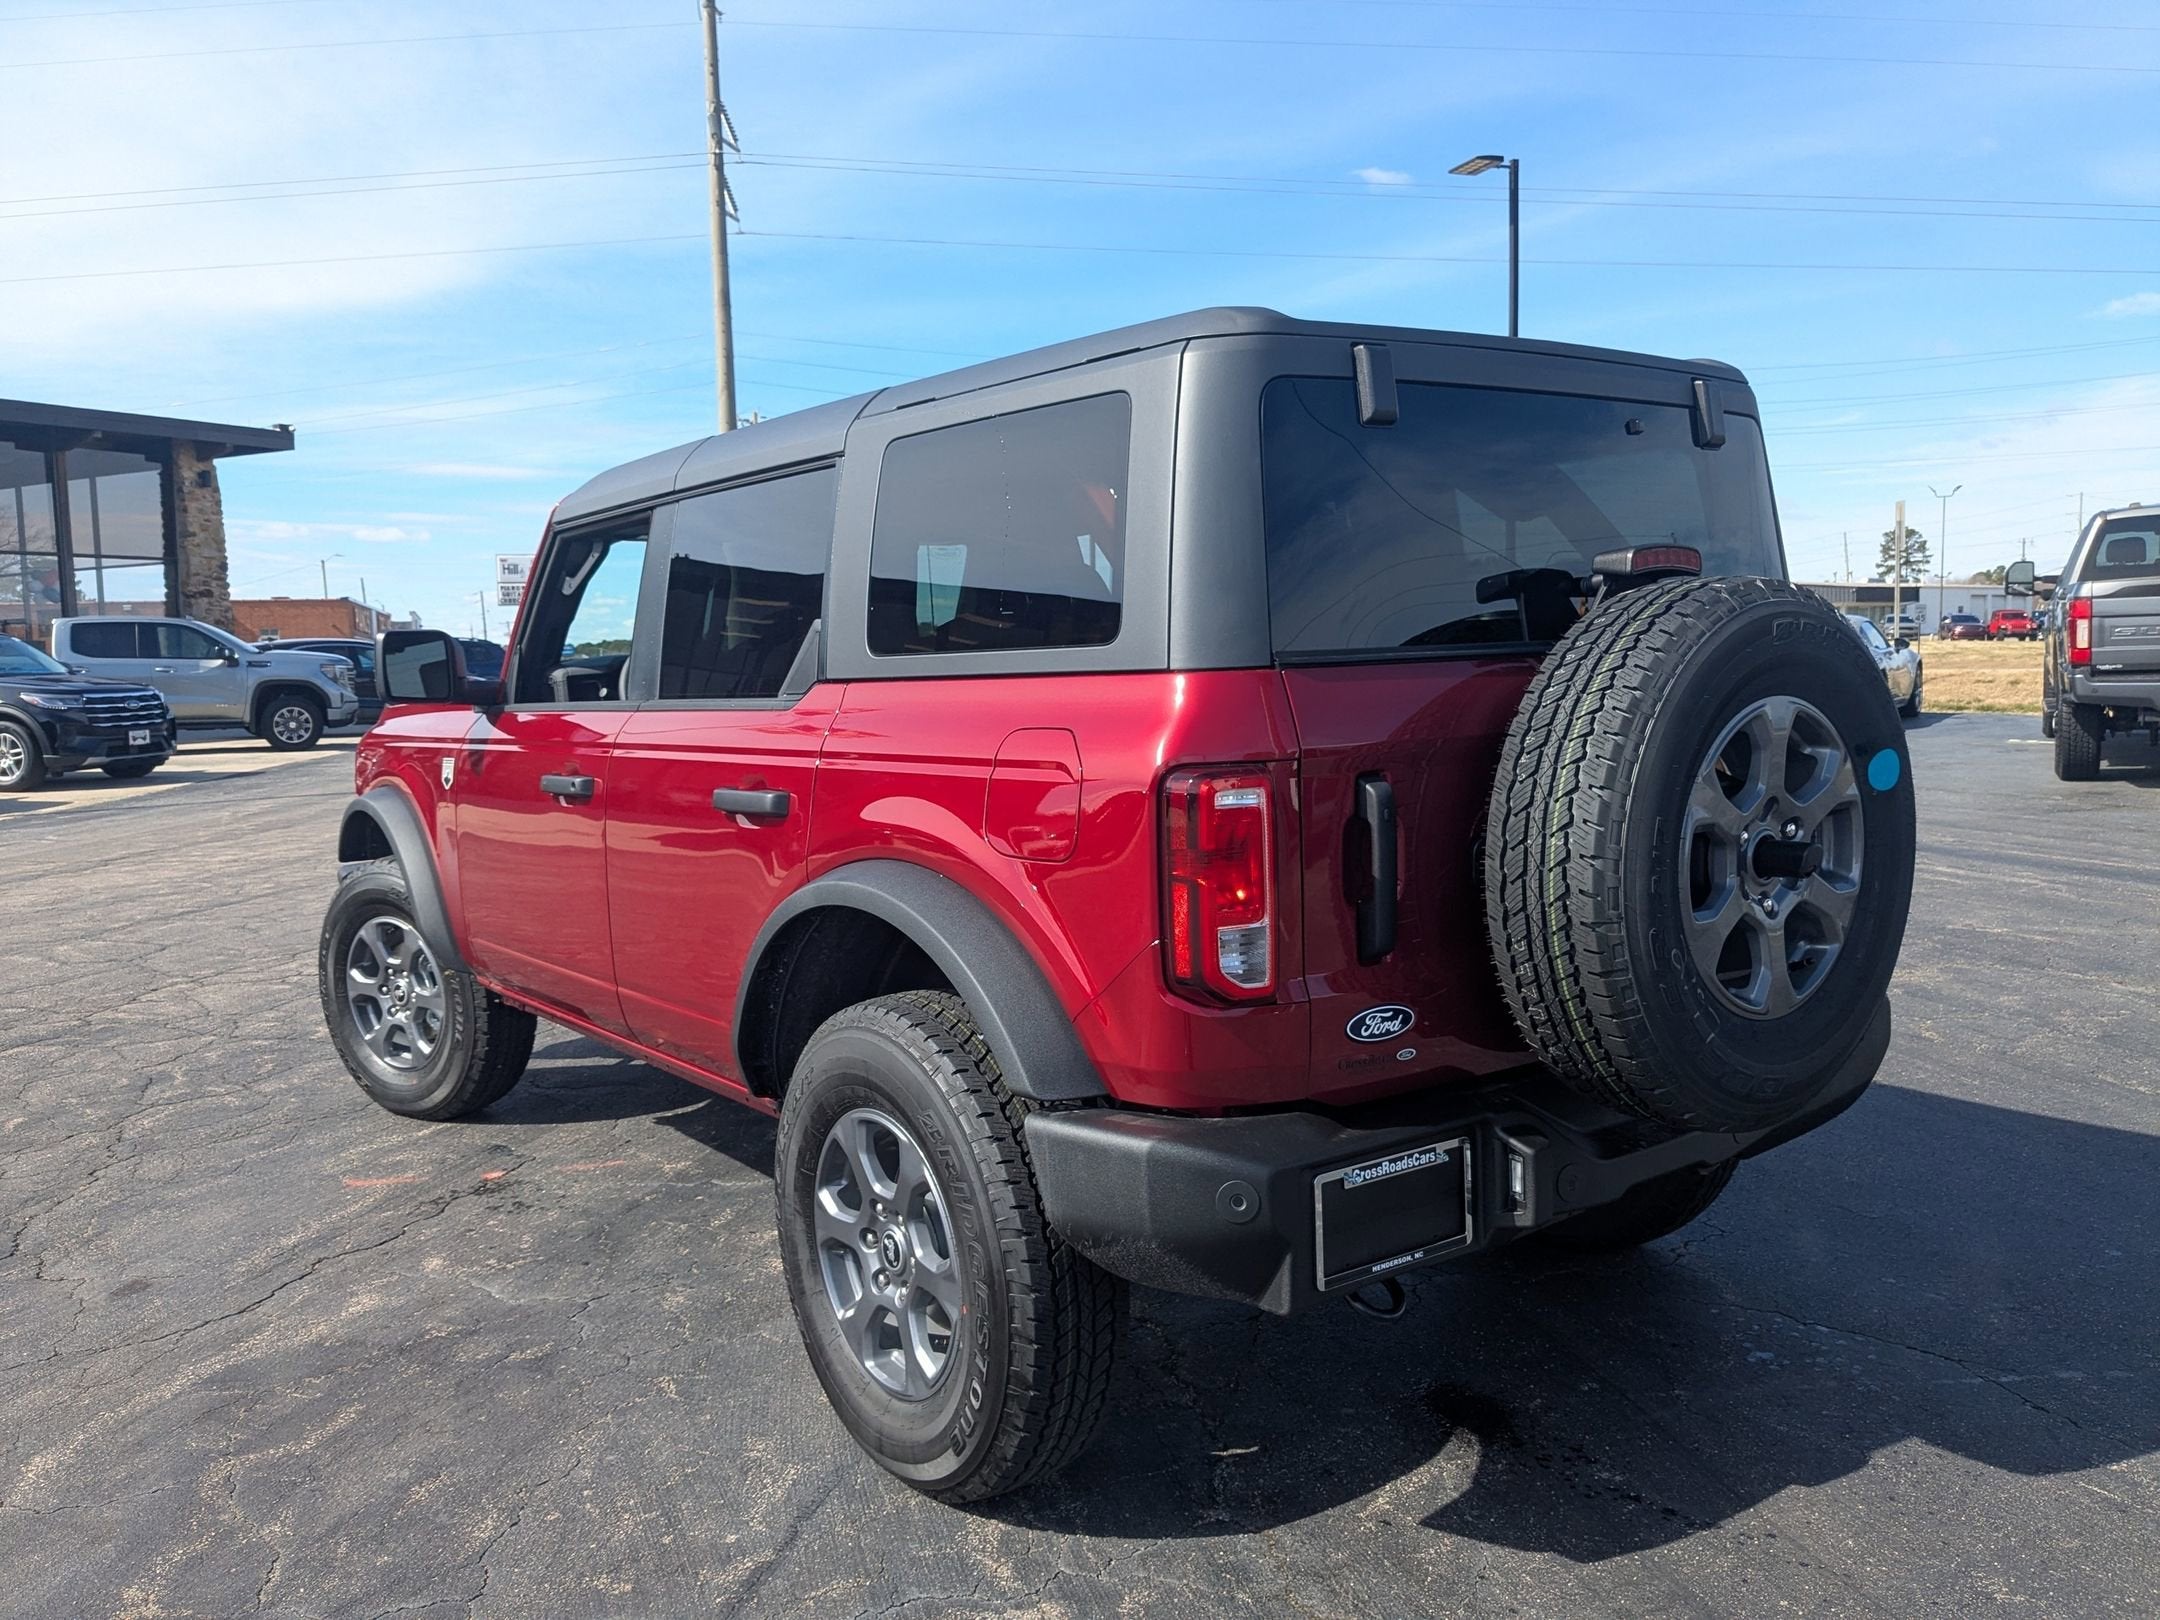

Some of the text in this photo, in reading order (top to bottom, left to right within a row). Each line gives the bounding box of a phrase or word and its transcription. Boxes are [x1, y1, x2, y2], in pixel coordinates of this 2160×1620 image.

[1361, 1011, 1403, 1037] Ford
[1352, 1152, 1436, 1182] CrossRoadsCars
[1372, 1251, 1424, 1272] HENDERSON, NC
[917, 1110, 990, 1458] BRIDGESTONE
